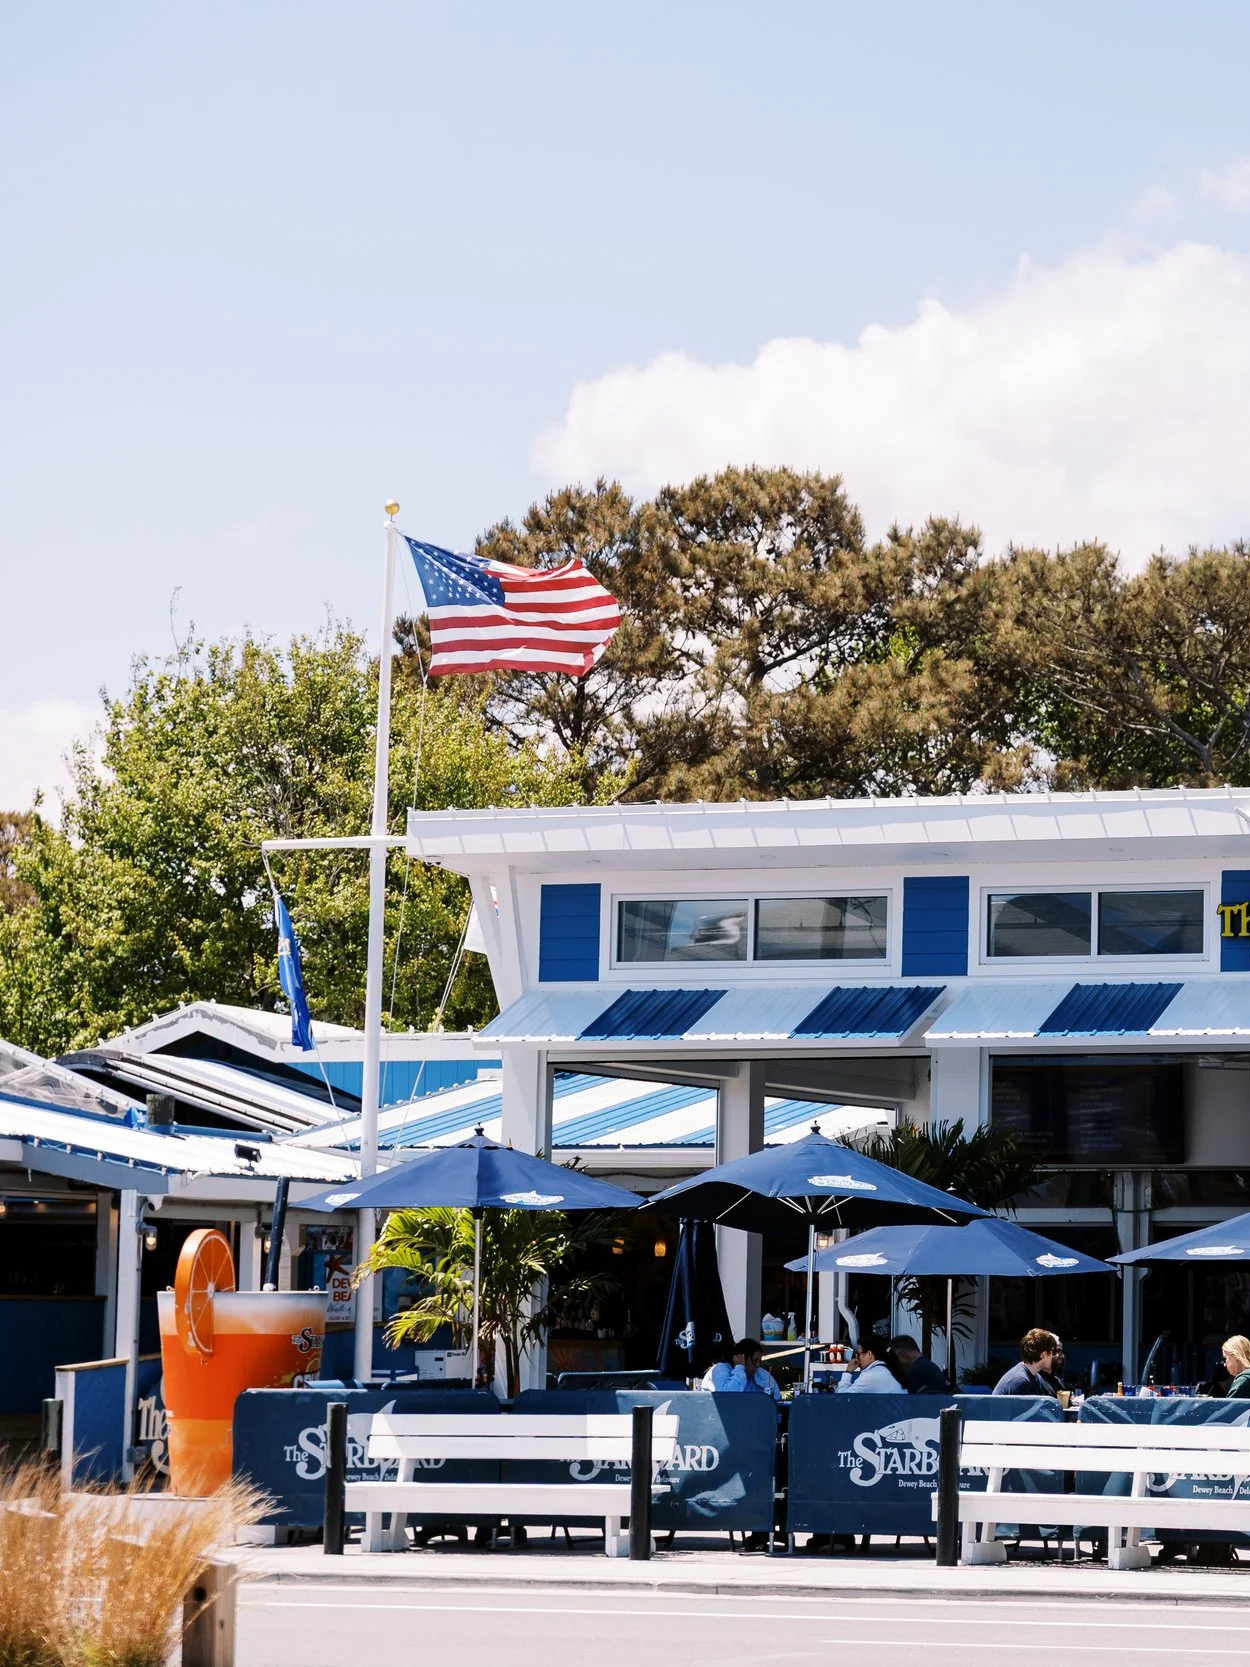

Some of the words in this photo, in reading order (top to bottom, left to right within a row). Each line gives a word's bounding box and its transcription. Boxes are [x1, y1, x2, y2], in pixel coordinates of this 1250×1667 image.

[284, 1445, 309, 1462] The
[838, 1450, 863, 1468] The
[362, 1473, 379, 1481] Beach
[615, 1474, 631, 1482] Dewe
[898, 1479, 919, 1489] Dewey
[919, 1479, 937, 1488] Beach
[1192, 1485, 1213, 1495] Dewey
[1214, 1485, 1233, 1494] Beach
